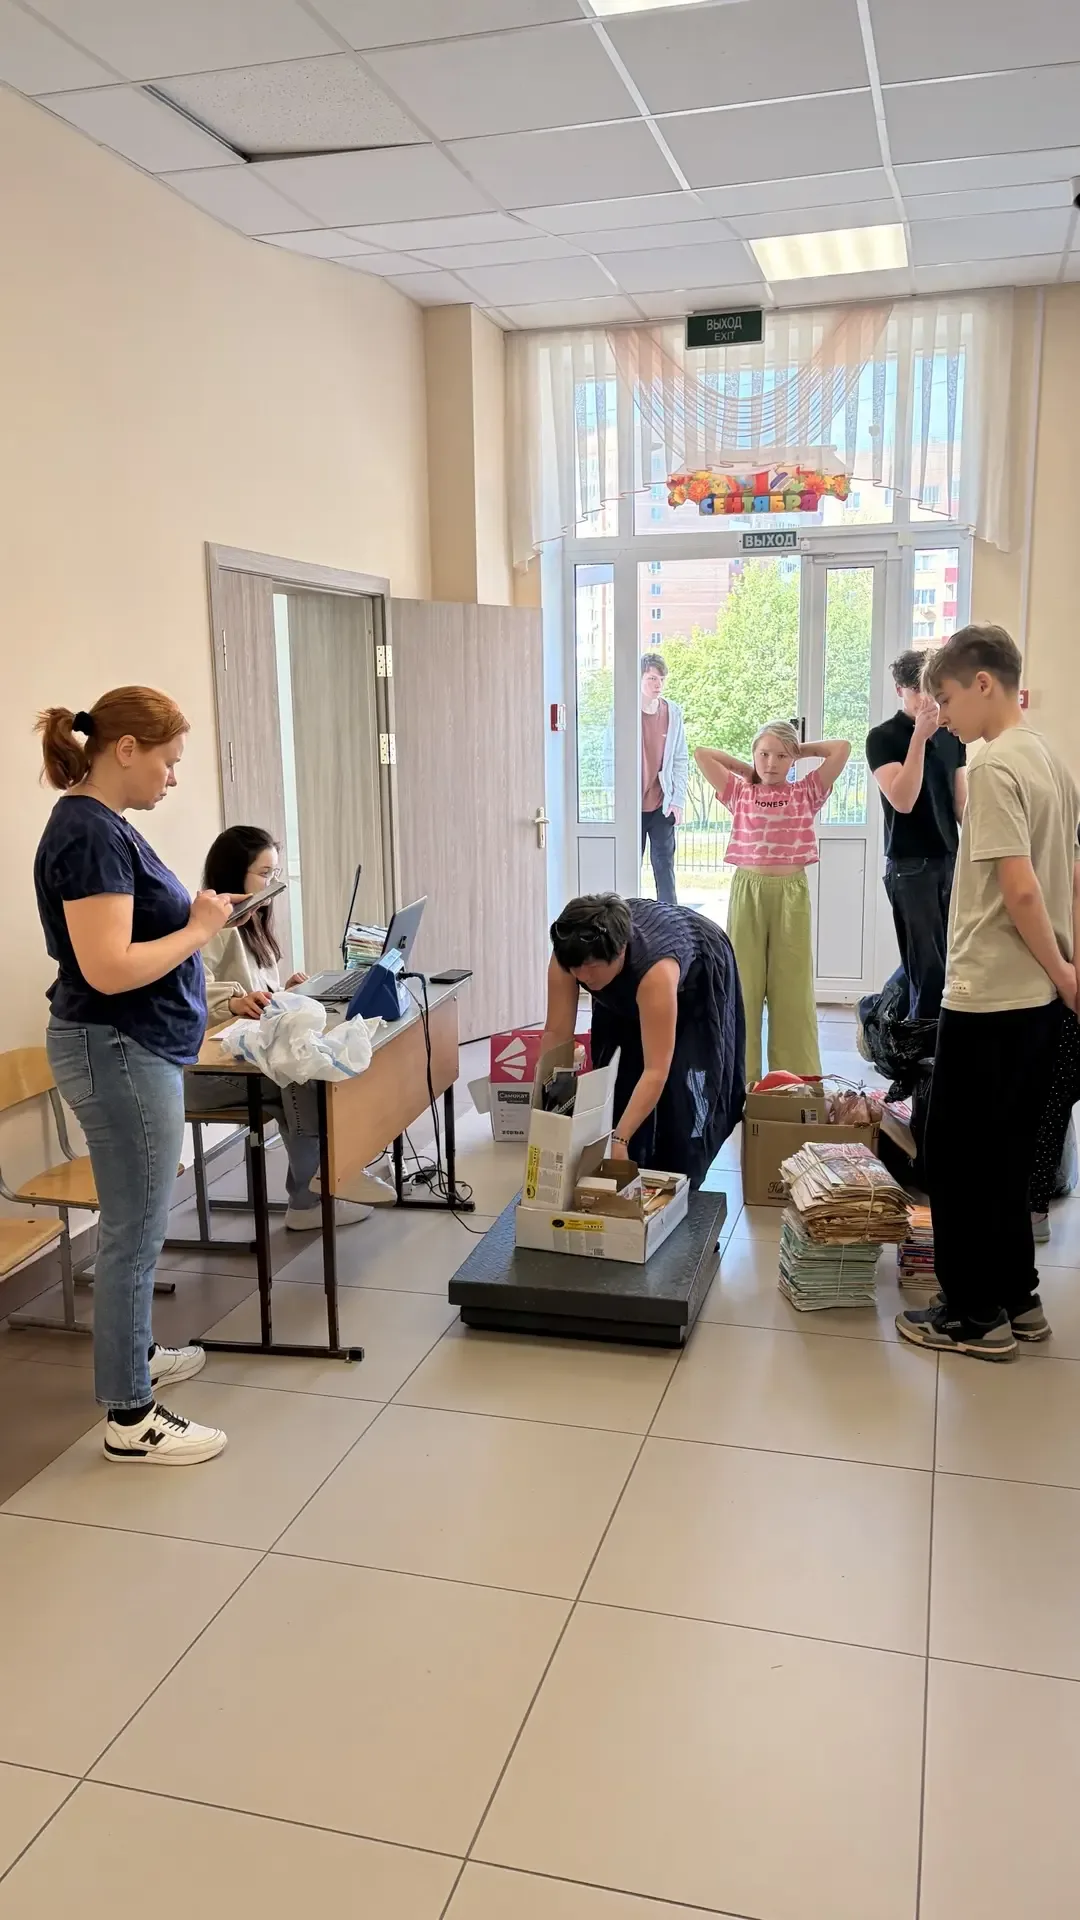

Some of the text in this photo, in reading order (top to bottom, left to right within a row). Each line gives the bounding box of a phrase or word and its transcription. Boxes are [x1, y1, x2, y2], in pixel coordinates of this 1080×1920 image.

[706, 316, 742, 331] ВЫХОД
[714, 331, 735, 341] EXIT
[699, 492, 818, 515] СЕНТЯБРЯ
[744, 533, 795, 548] ВЫХОД
[139, 1428, 166, 1446] N
